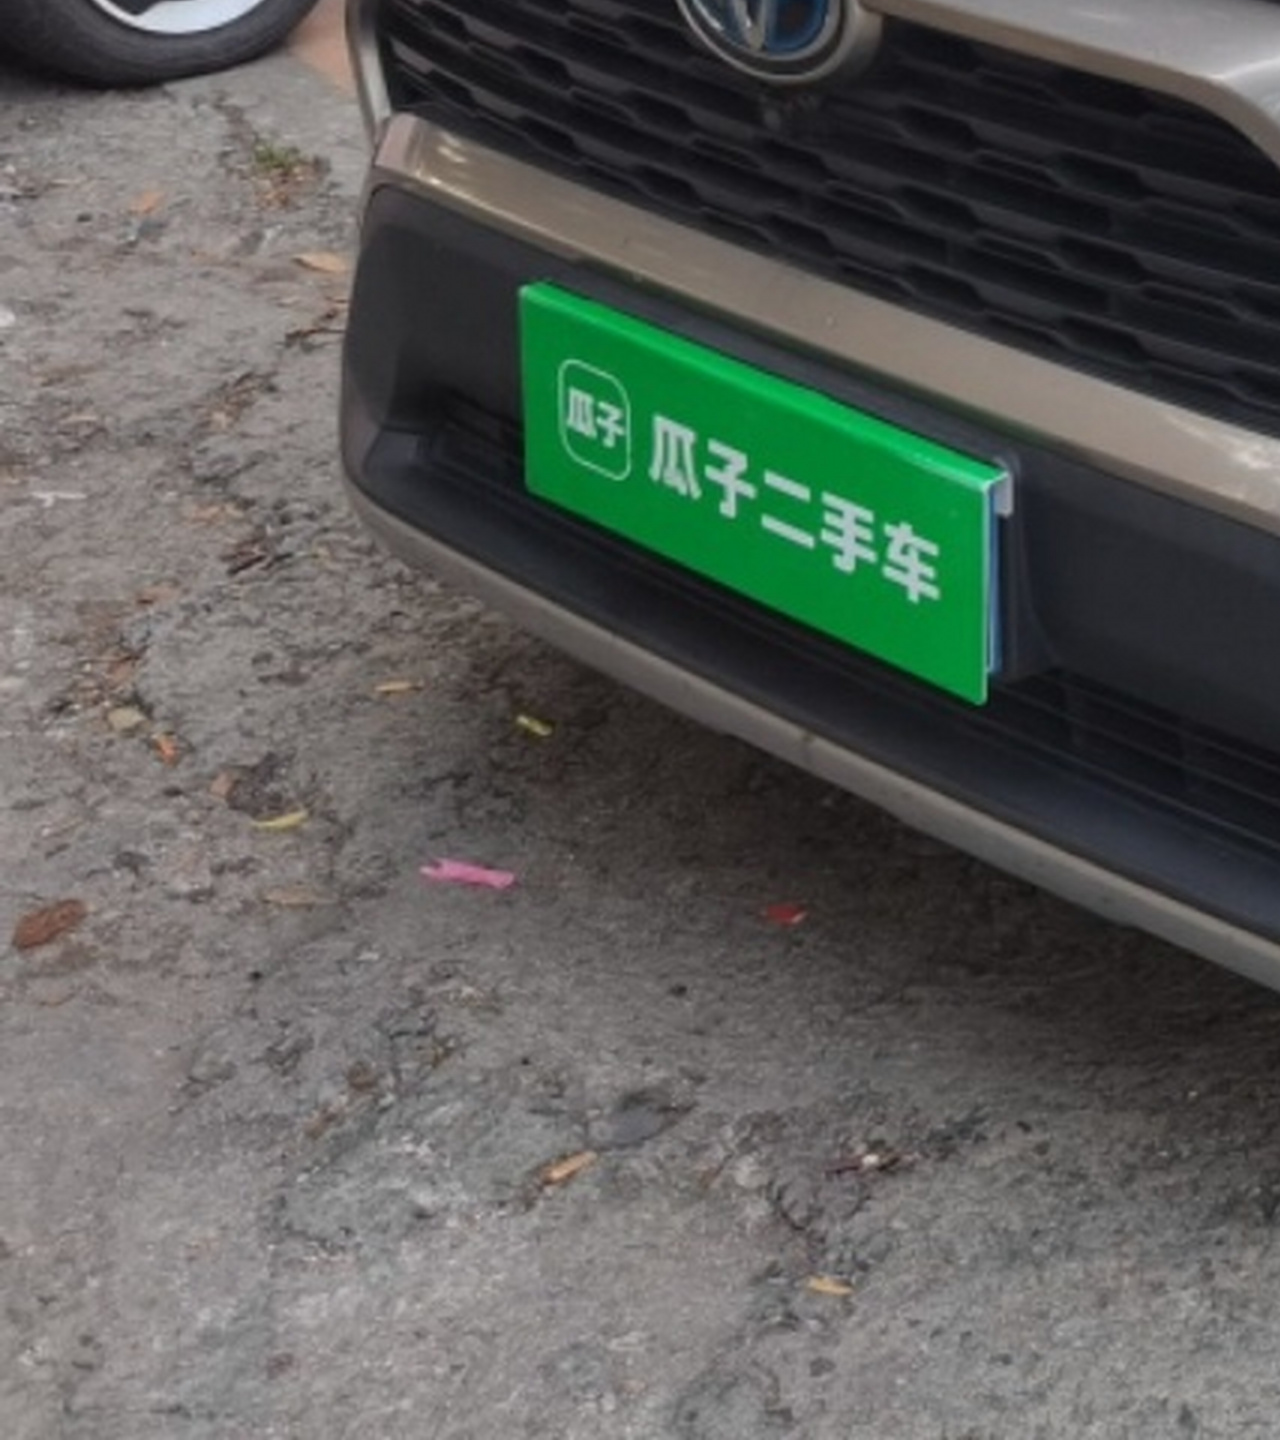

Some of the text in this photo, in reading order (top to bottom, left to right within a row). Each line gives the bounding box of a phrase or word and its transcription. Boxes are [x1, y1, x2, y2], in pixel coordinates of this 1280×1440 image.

[565, 386, 626, 448] 瓜子
[648, 413, 941, 604] 瓜子二手车
